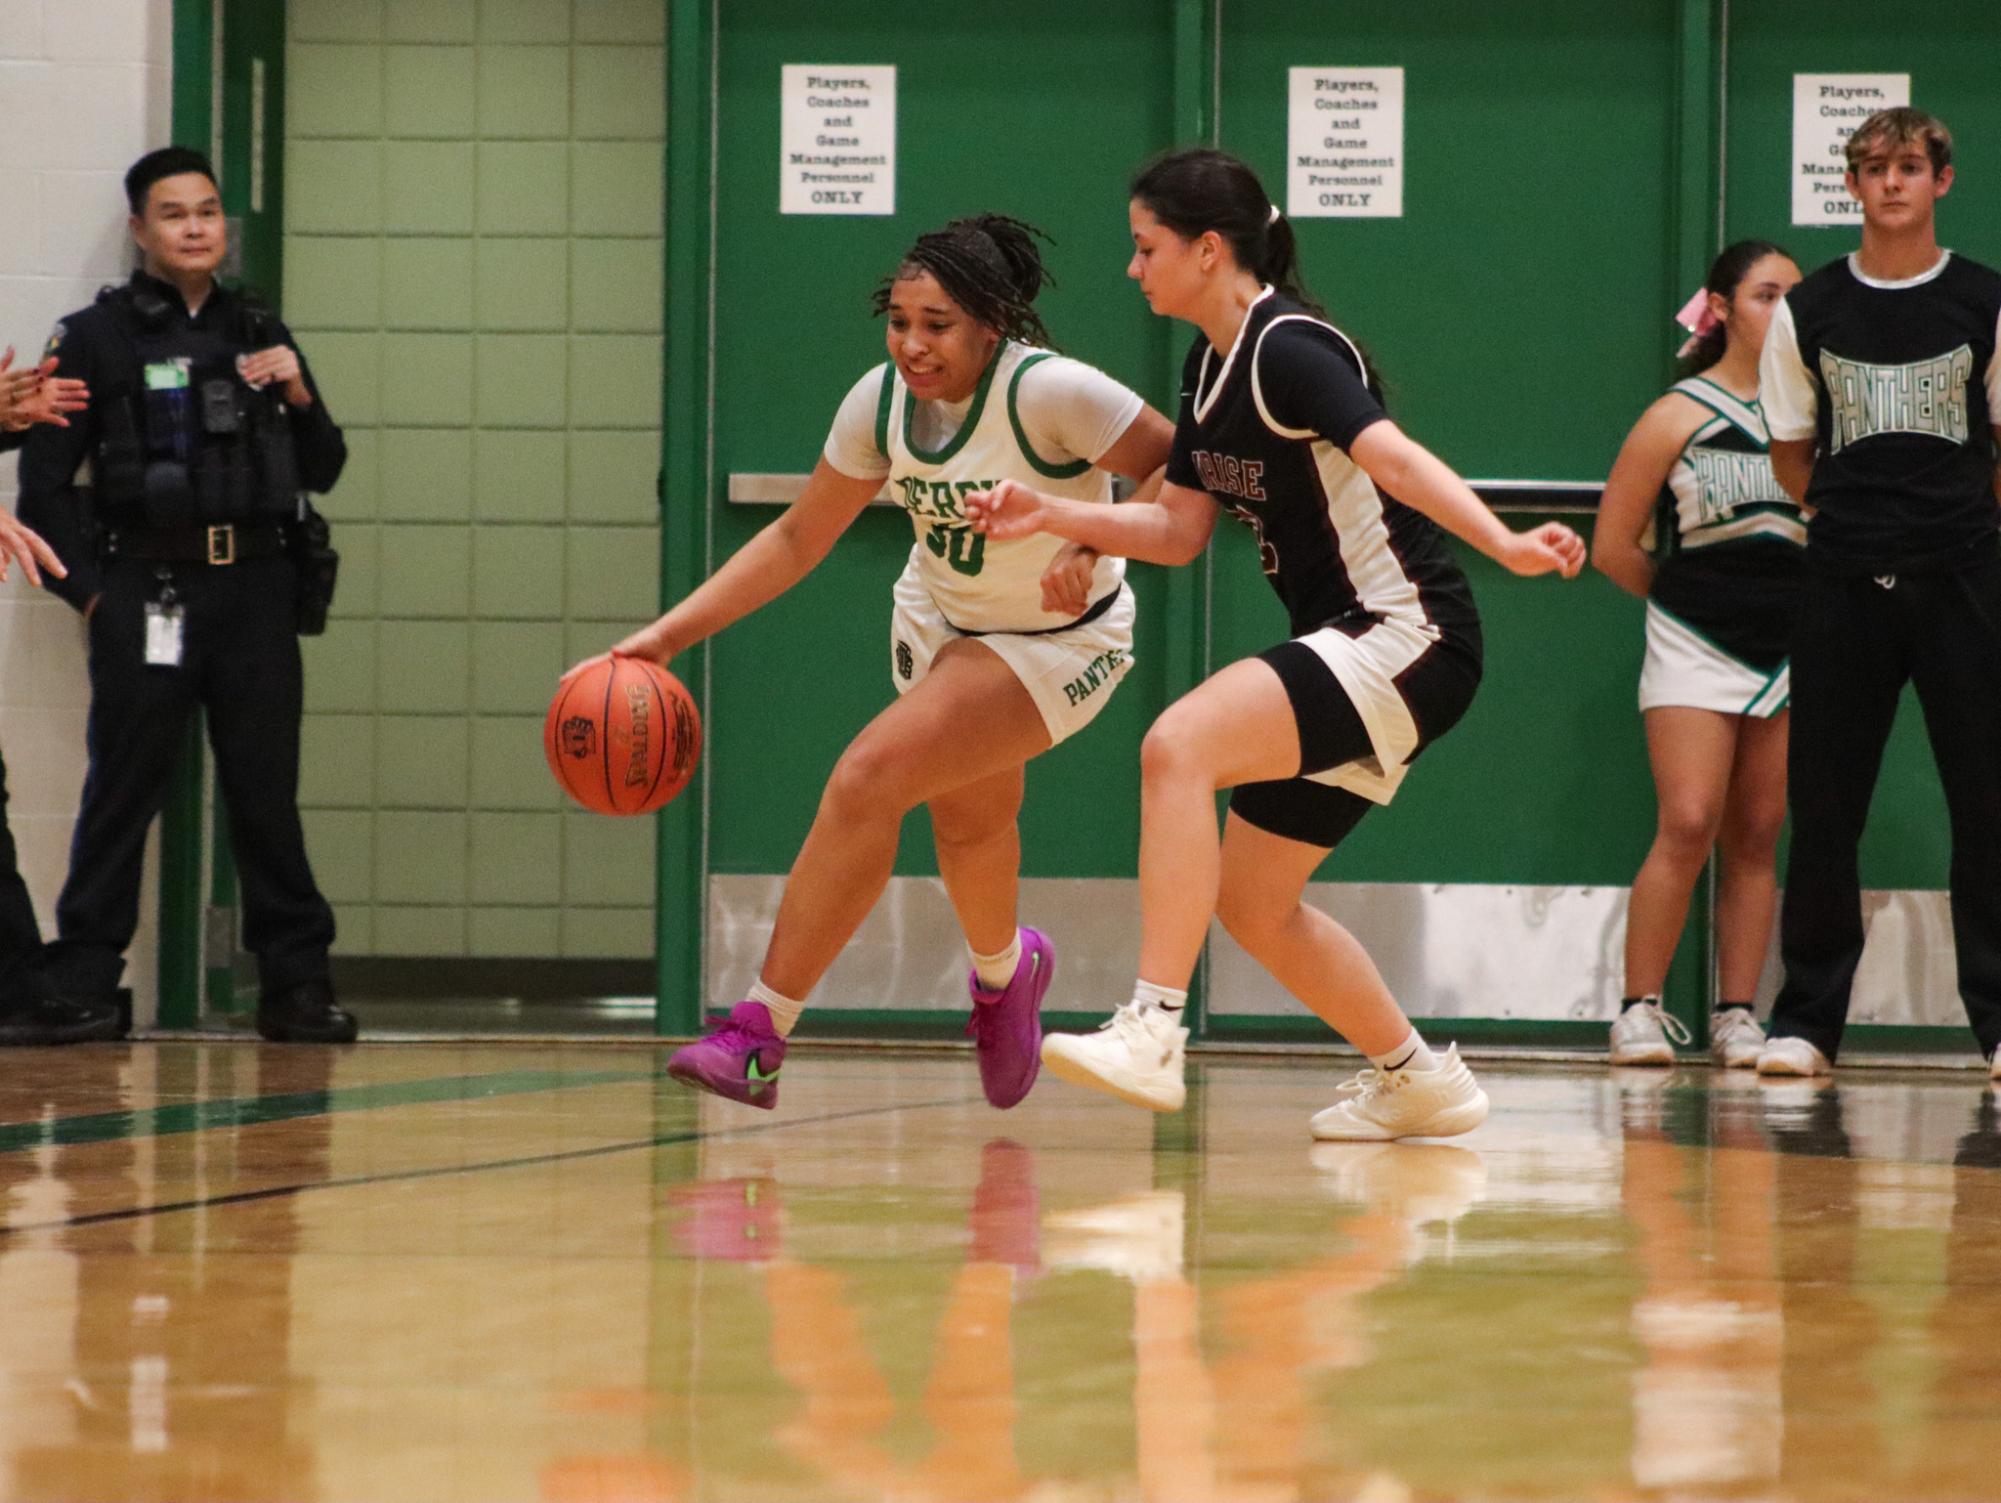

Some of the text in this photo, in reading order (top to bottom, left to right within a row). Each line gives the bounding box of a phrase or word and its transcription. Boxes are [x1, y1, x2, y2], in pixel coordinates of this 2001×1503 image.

[807, 77, 871, 90] Players,
[1314, 79, 1379, 92] Players,
[1819, 86, 1885, 100] Players,
[807, 96, 870, 108] Coaches
[1314, 98, 1378, 110] Coaches
[824, 116, 852, 127] and
[1331, 118, 1360, 130] and
[1837, 127, 1855, 137] an
[816, 135, 859, 146] Game
[1323, 137, 1368, 149] Game
[790, 154, 886, 166] Management
[1296, 156, 1394, 170] Management
[801, 172, 874, 183] Personnel
[1308, 175, 1382, 186] Personnel
[811, 192, 863, 204] ONLY
[1318, 194, 1371, 207] ONLY
[1824, 201, 1864, 214] ONL
[1819, 343, 1973, 455] PANTHERS
[624, 683, 650, 788] SPALDING
